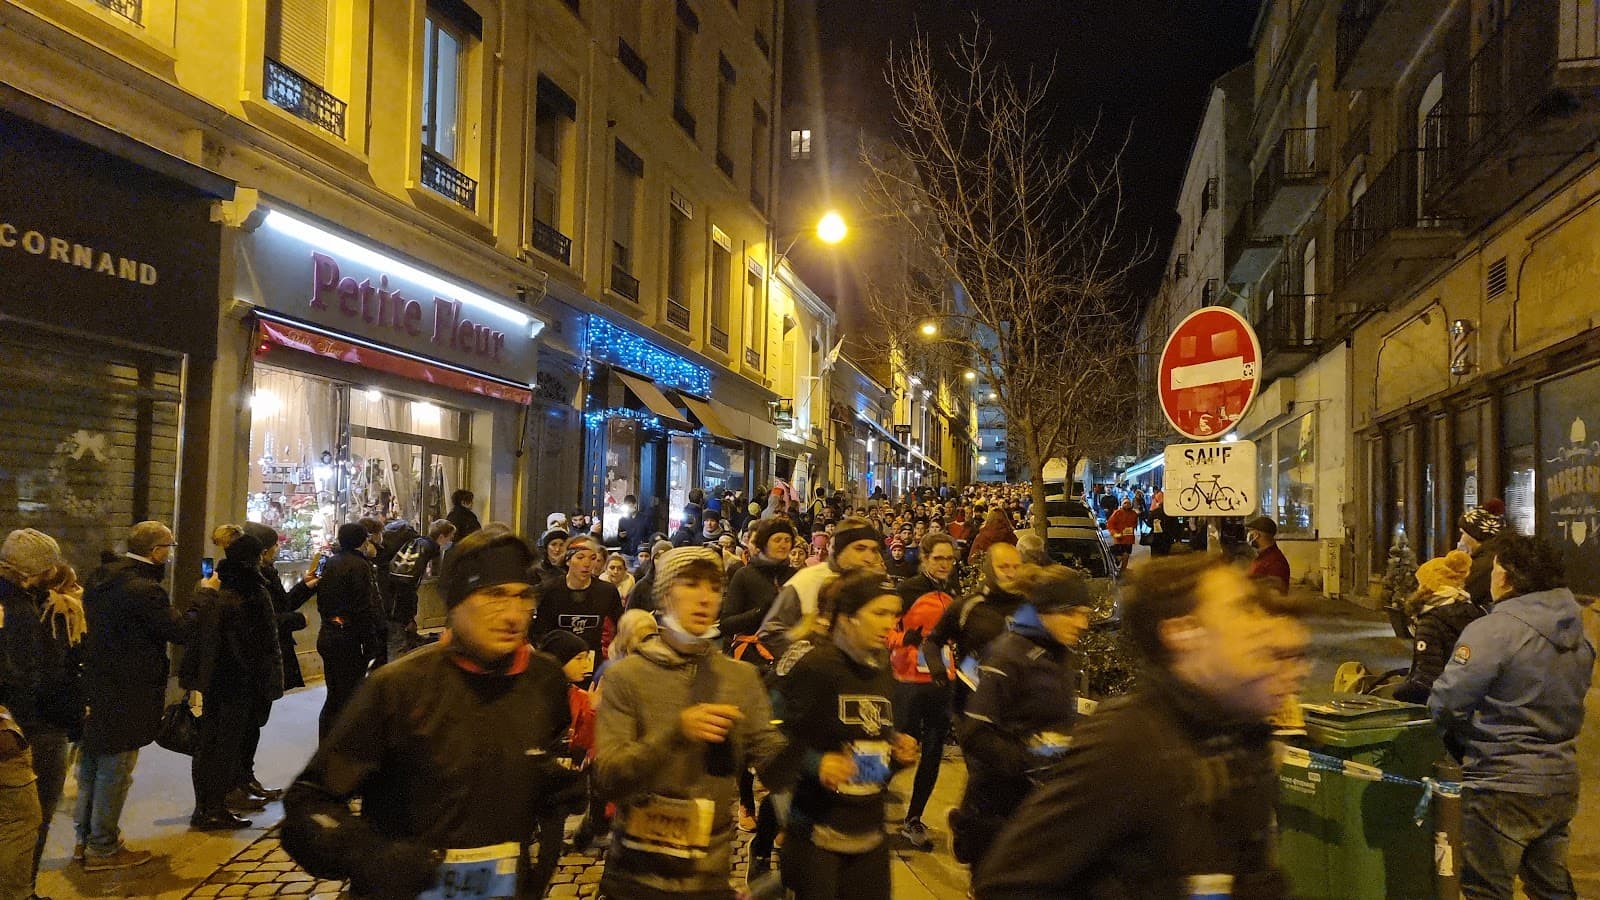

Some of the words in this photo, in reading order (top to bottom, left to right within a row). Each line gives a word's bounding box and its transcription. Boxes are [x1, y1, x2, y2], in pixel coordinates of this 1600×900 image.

[0, 223, 157, 286] CORNAND
[309, 250, 422, 337] Petite
[430, 295, 505, 361] Fleur
[1184, 446, 1232, 465] SAUF
